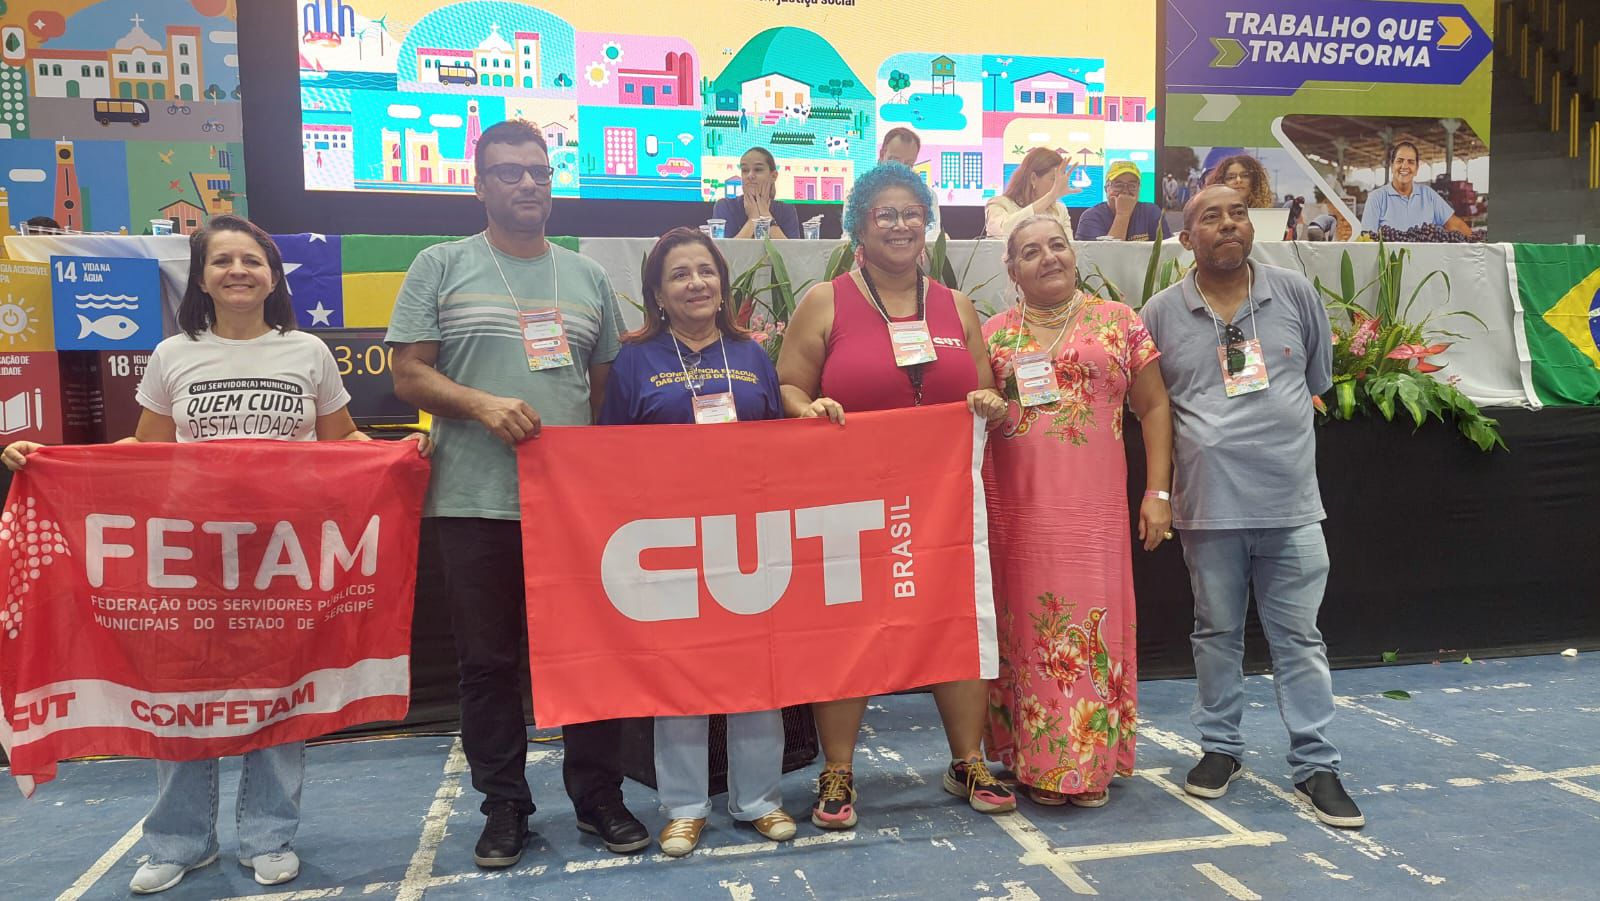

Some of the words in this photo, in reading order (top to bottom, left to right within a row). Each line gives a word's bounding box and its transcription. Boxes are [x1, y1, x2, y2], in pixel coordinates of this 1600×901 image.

[1225, 12, 1371, 39] TRABALHO
[1378, 18, 1434, 42] QUE
[1249, 40, 1431, 67] TRANSFORMA
[55, 261, 77, 283] 14
[82, 262, 100, 272] VIDA
[100, 263, 111, 272] NA
[83, 272, 103, 282] ÁGUA
[933, 337, 961, 346] CUT
[20, 355, 30, 364] DE
[108, 355, 130, 377] 18
[335, 345, 393, 375] 3:0
[192, 383, 207, 393] SOU
[208, 380, 258, 390] SERVIDOR(A)
[260, 381, 300, 393] MUNICIPAL
[655, 378, 673, 388] DAS
[187, 394, 243, 417] QUEM
[248, 394, 304, 415] CUIDA
[189, 415, 238, 439] DESTA
[243, 414, 303, 437] CIDADE
[85, 513, 380, 592] FETAM
[890, 495, 915, 599] BRASIL
[601, 499, 885, 622] CUT
[90, 595, 181, 614] FEDERAÇÃO
[187, 598, 218, 611] DOS
[223, 598, 313, 612] SERVIDORES
[94, 613, 179, 631] MUNICIPAIS
[194, 617, 215, 630] DO
[228, 617, 285, 630] ESTADO
[297, 617, 315, 630] DE
[323, 599, 375, 622] SERGIPE
[131, 681, 315, 727] CONFETAM
